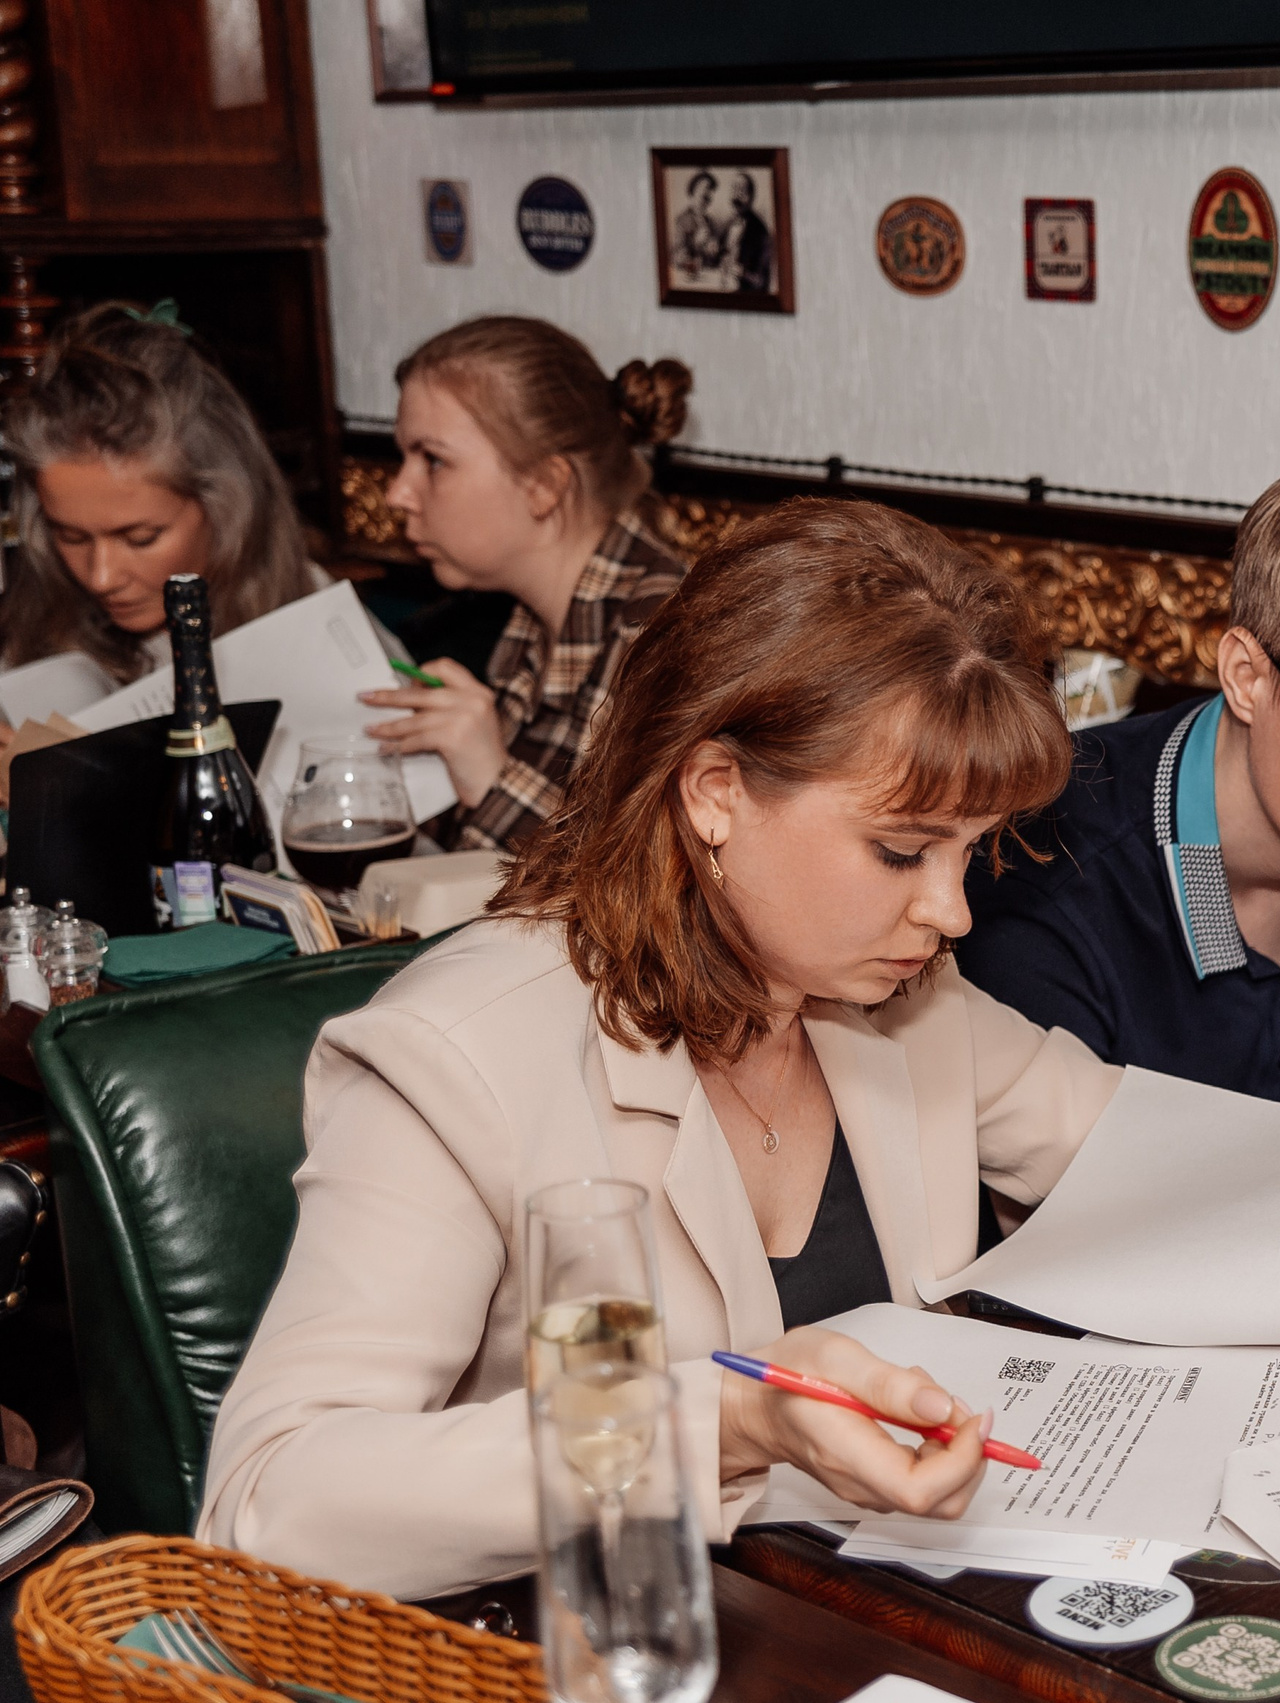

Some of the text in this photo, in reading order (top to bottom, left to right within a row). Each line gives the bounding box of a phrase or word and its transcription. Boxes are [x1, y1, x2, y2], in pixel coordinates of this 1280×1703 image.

[1176, 1367, 1201, 1401] QUESTIONS
[1037, 1443, 1053, 1460] говорил
[1056, 1608, 1106, 1630] MENU
